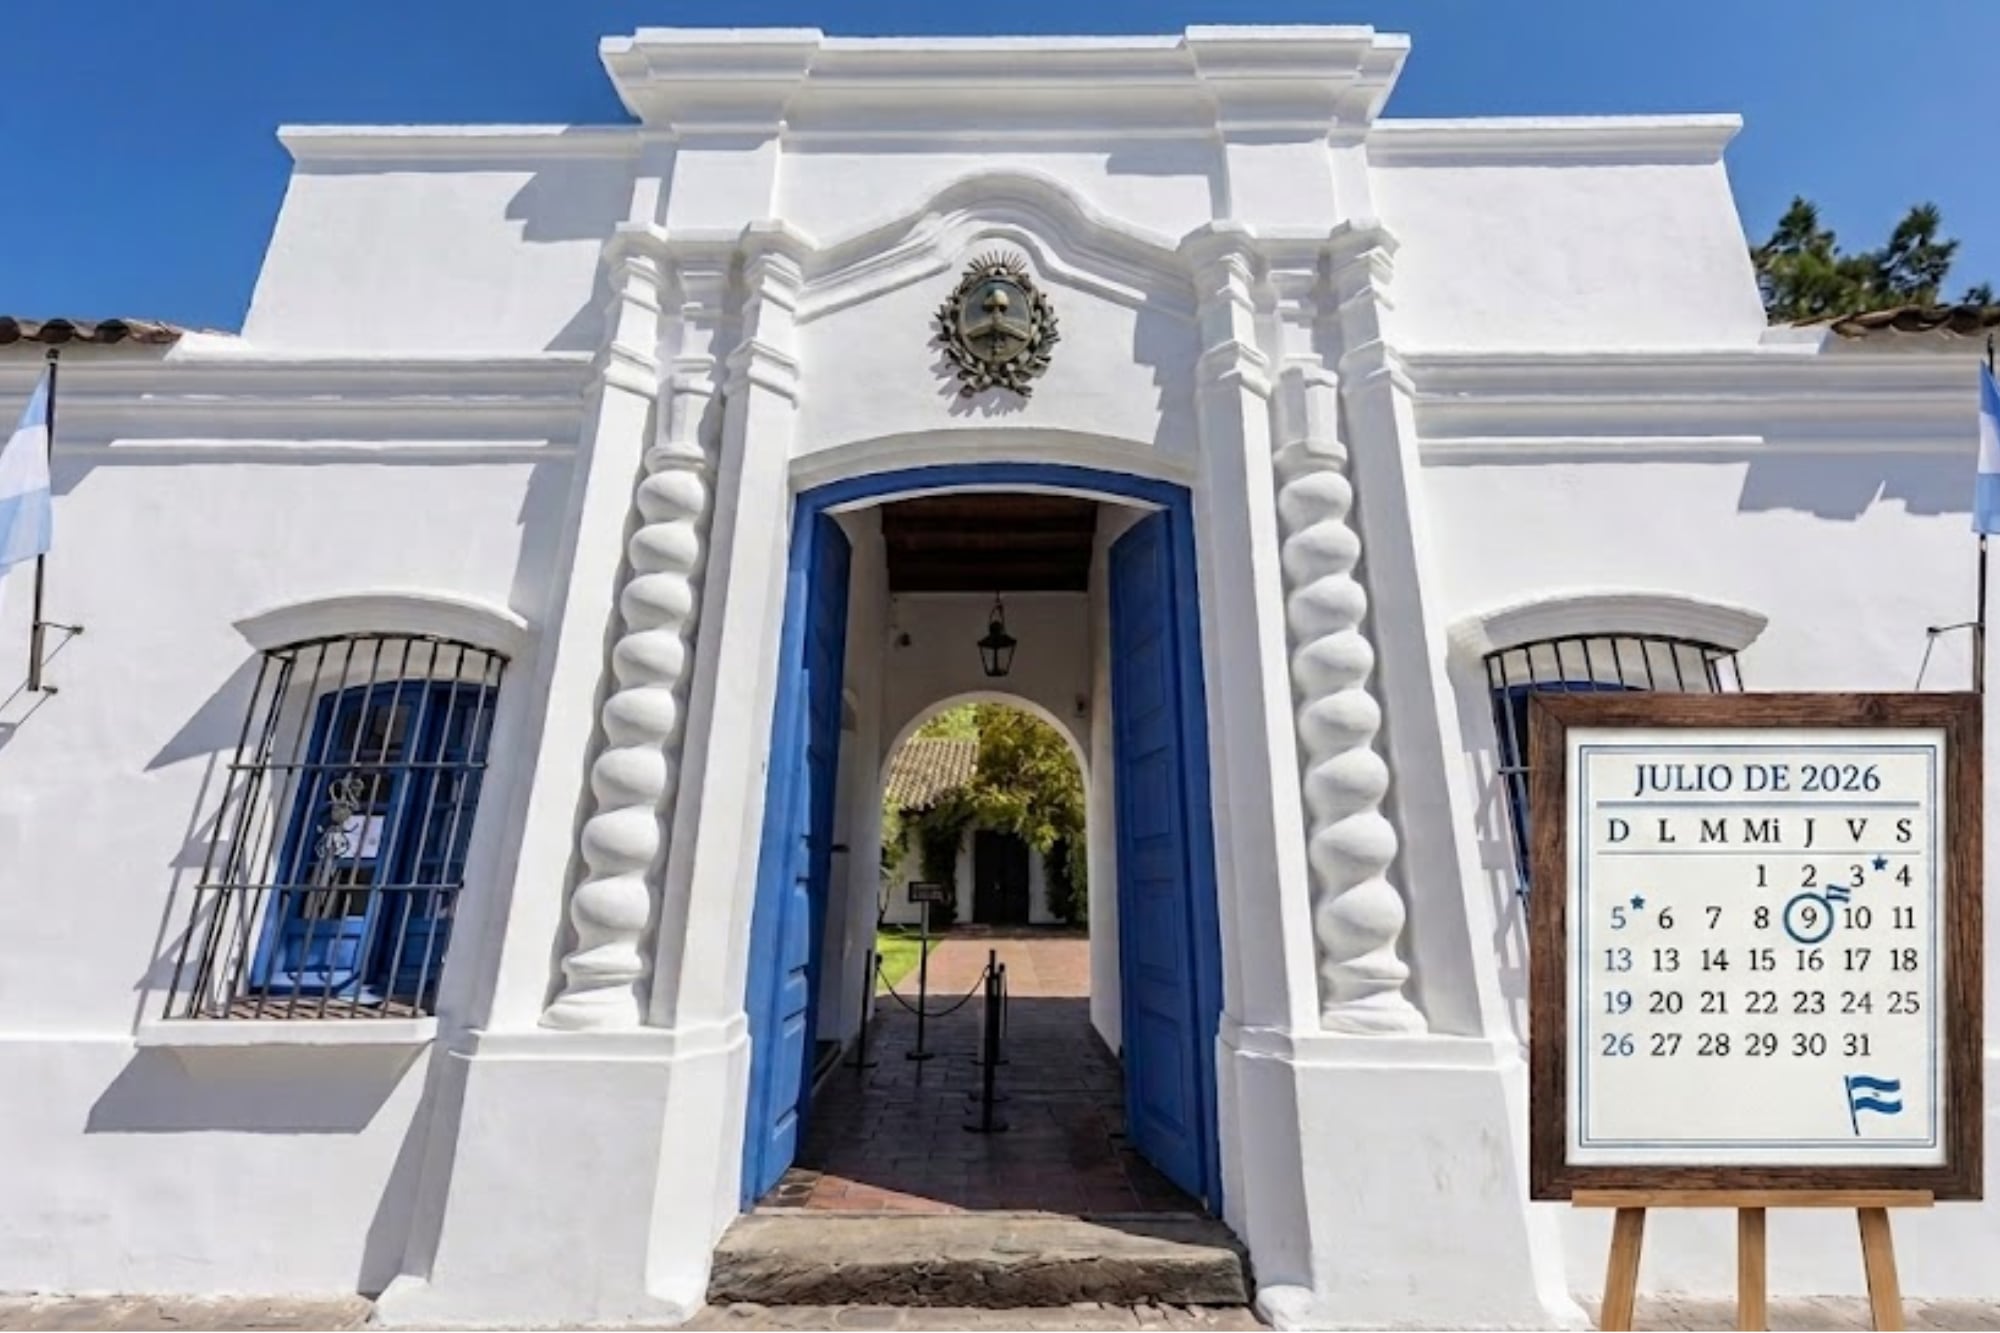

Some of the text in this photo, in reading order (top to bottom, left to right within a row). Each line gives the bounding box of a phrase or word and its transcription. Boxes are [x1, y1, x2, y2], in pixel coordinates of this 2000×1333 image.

[1634, 763, 1881, 798] JULIO DE 2026
[1607, 817, 1913, 849] D L M Mi J V S
[1756, 863, 1913, 888] 1 2 3 4
[1610, 905, 1916, 930] 5 6 7 8 9 10 11
[1604, 947, 1919, 973] 13 13 14 15 16 17 18
[1605, 990, 1921, 1015] 19 20 21 22 23 24 25
[1601, 1032, 1871, 1057] 26 27 28 29 30 31
